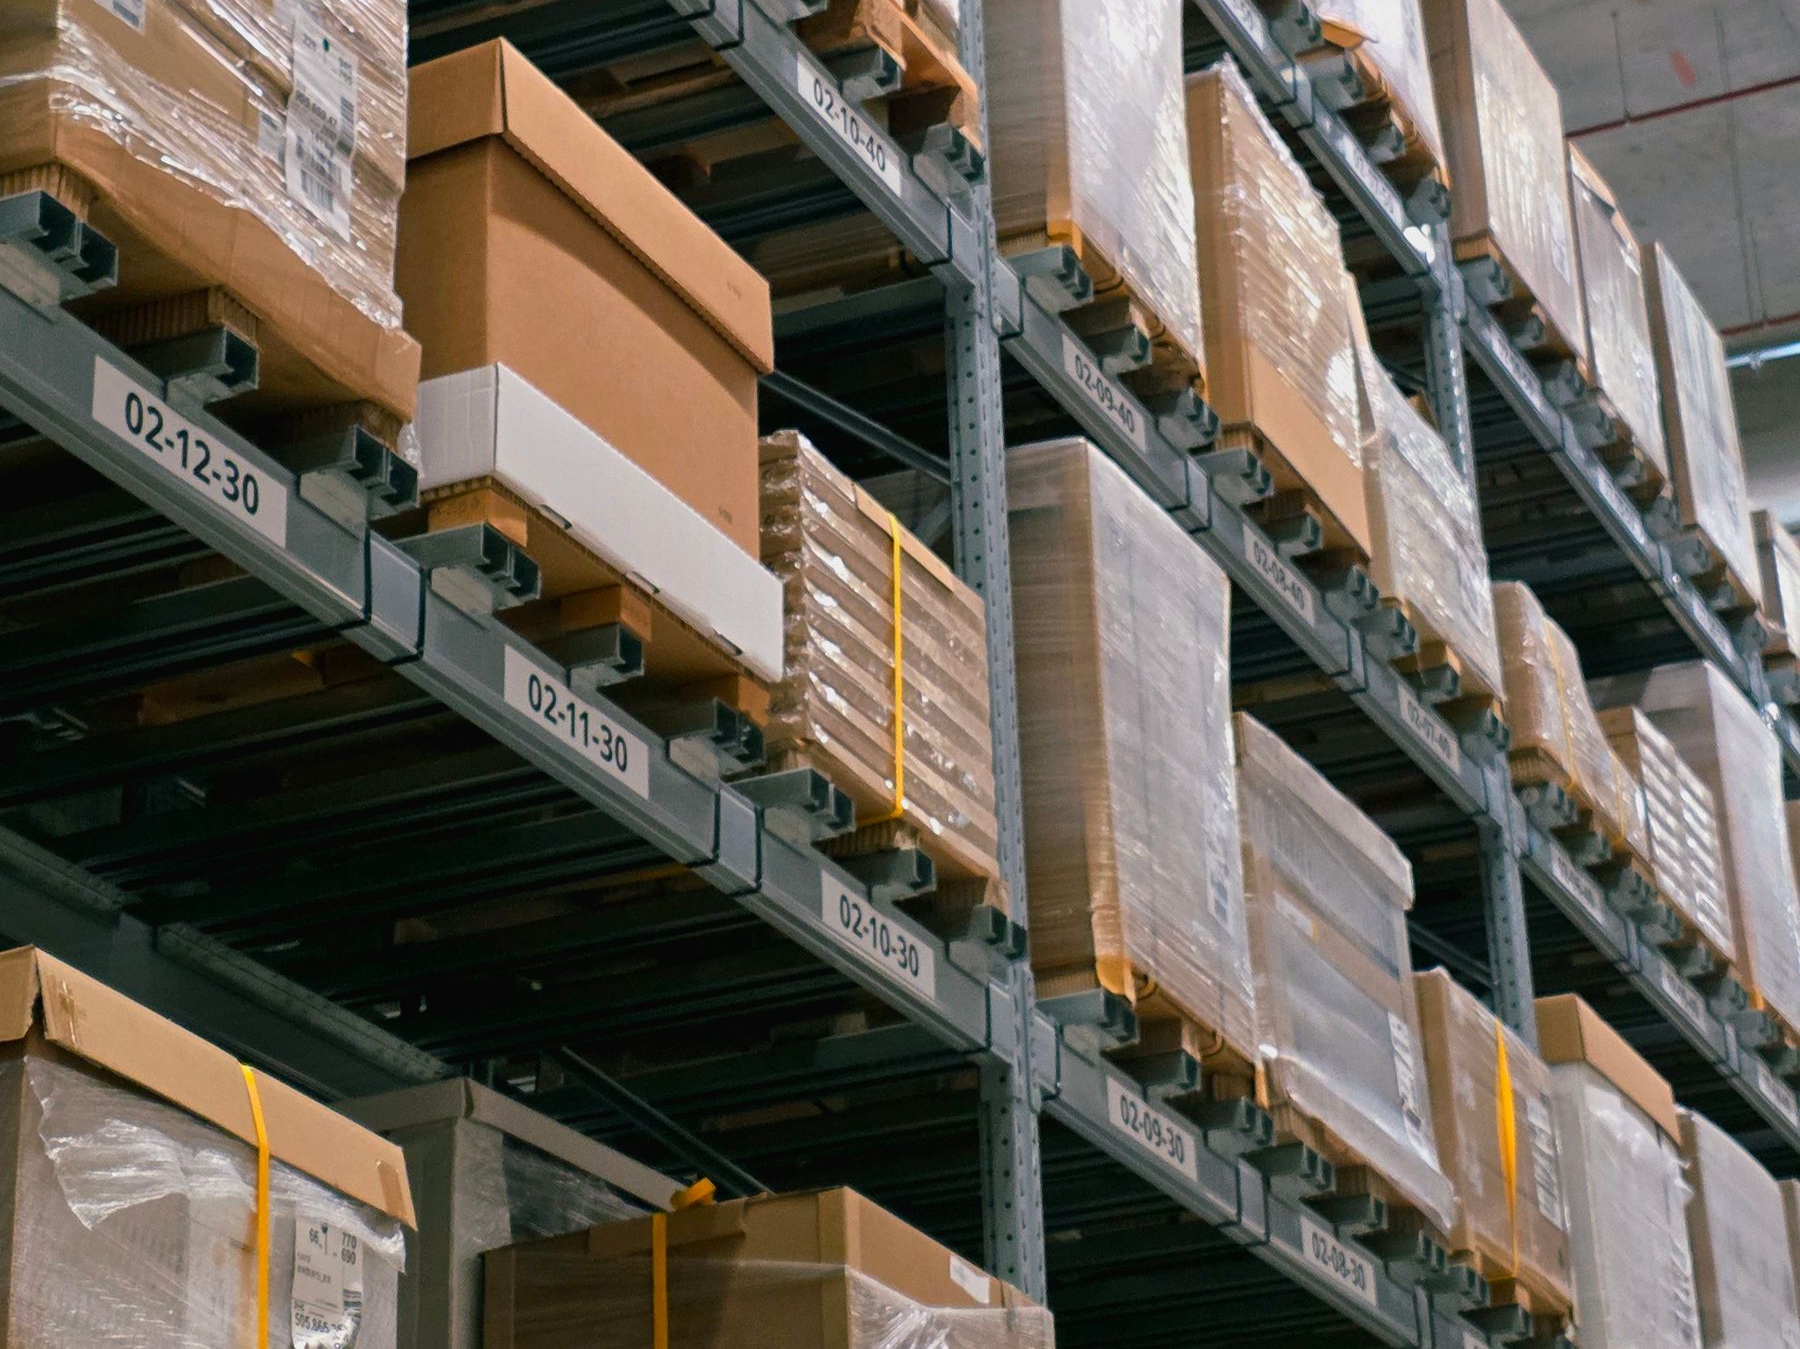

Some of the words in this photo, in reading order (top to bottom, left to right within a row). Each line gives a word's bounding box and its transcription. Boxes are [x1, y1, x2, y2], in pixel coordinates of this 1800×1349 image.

[814, 78, 886, 171] 02-10-40
[1075, 354, 1135, 433] 02-09-40
[125, 392, 259, 515] 02-12-30
[528, 673, 628, 772] 02-11-30
[840, 894, 919, 977] 02-10-30
[1121, 1094, 1184, 1164] 02-09-30
[1312, 1232, 1366, 1291] 02-08-30
